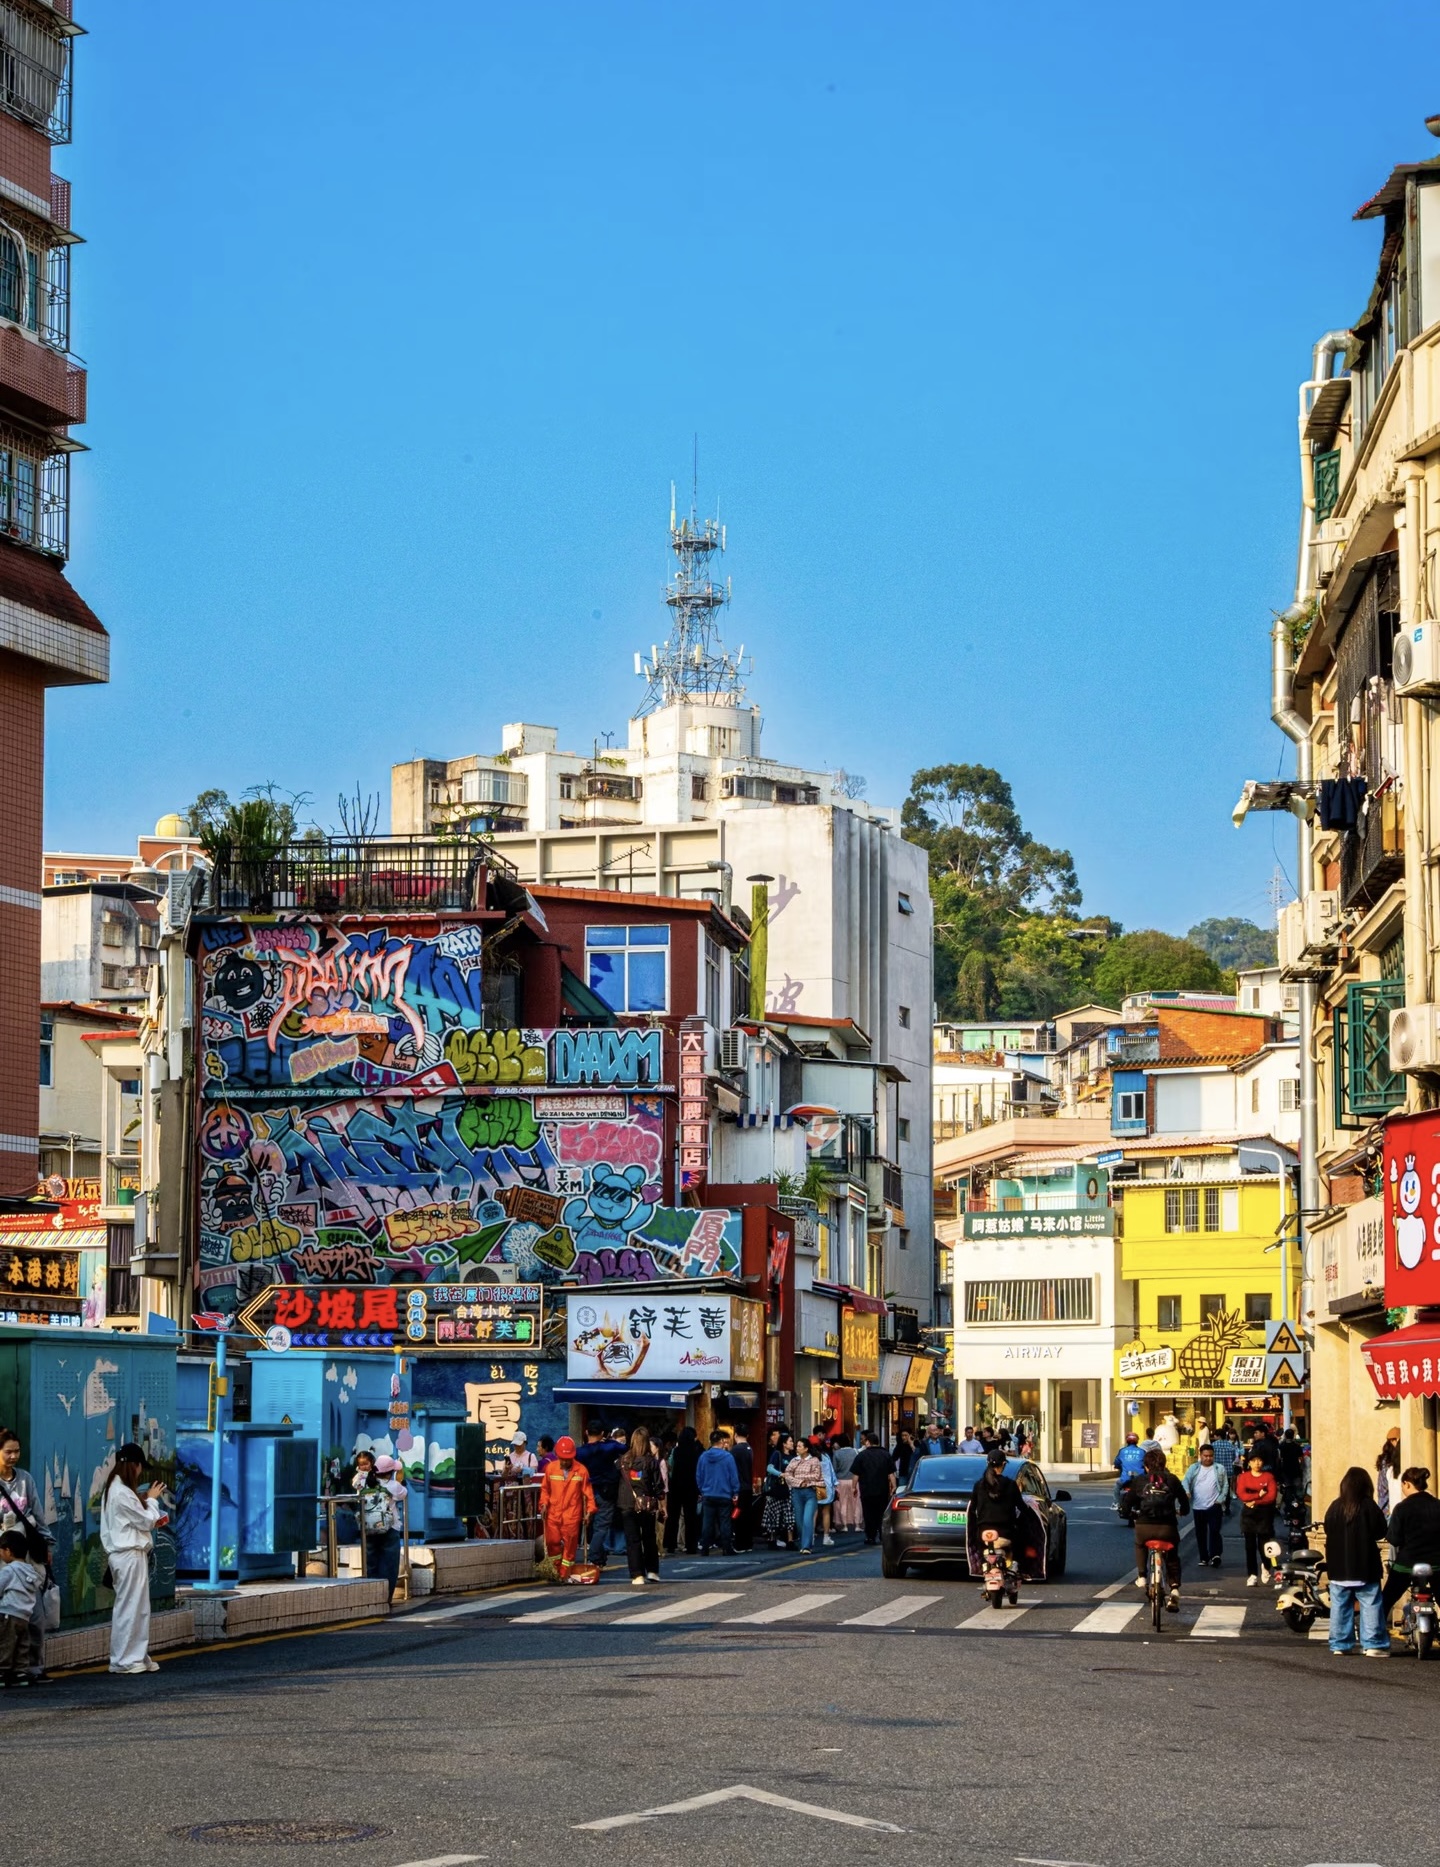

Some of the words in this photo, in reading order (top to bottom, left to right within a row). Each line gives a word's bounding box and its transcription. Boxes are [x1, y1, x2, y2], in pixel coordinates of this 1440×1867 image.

[539, 1097, 623, 1110] 我在沙坡尾等你
[556, 1181, 582, 1193] XM
[971, 1217, 1024, 1234] 阿惹姑娘
[1030, 1216, 1082, 1232] 马来小馆
[1084, 1215, 1106, 1223] Little
[1084, 1222, 1106, 1231] Nonya
[433, 1286, 539, 1303] 我在厦门很想你
[274, 1287, 399, 1329] 沙坡尾
[456, 1304, 513, 1319] 台湾小吃
[629, 1306, 727, 1340] 舒芙蕾
[439, 1320, 531, 1340] 网红舒芙蕾
[1005, 1347, 1062, 1359] AIRWAY
[1235, 1357, 1263, 1368] 厦门
[1232, 1368, 1261, 1378] 沙坡尾
[1279, 1373, 1290, 1385] 慢
[524, 1364, 539, 1396] 吃了
